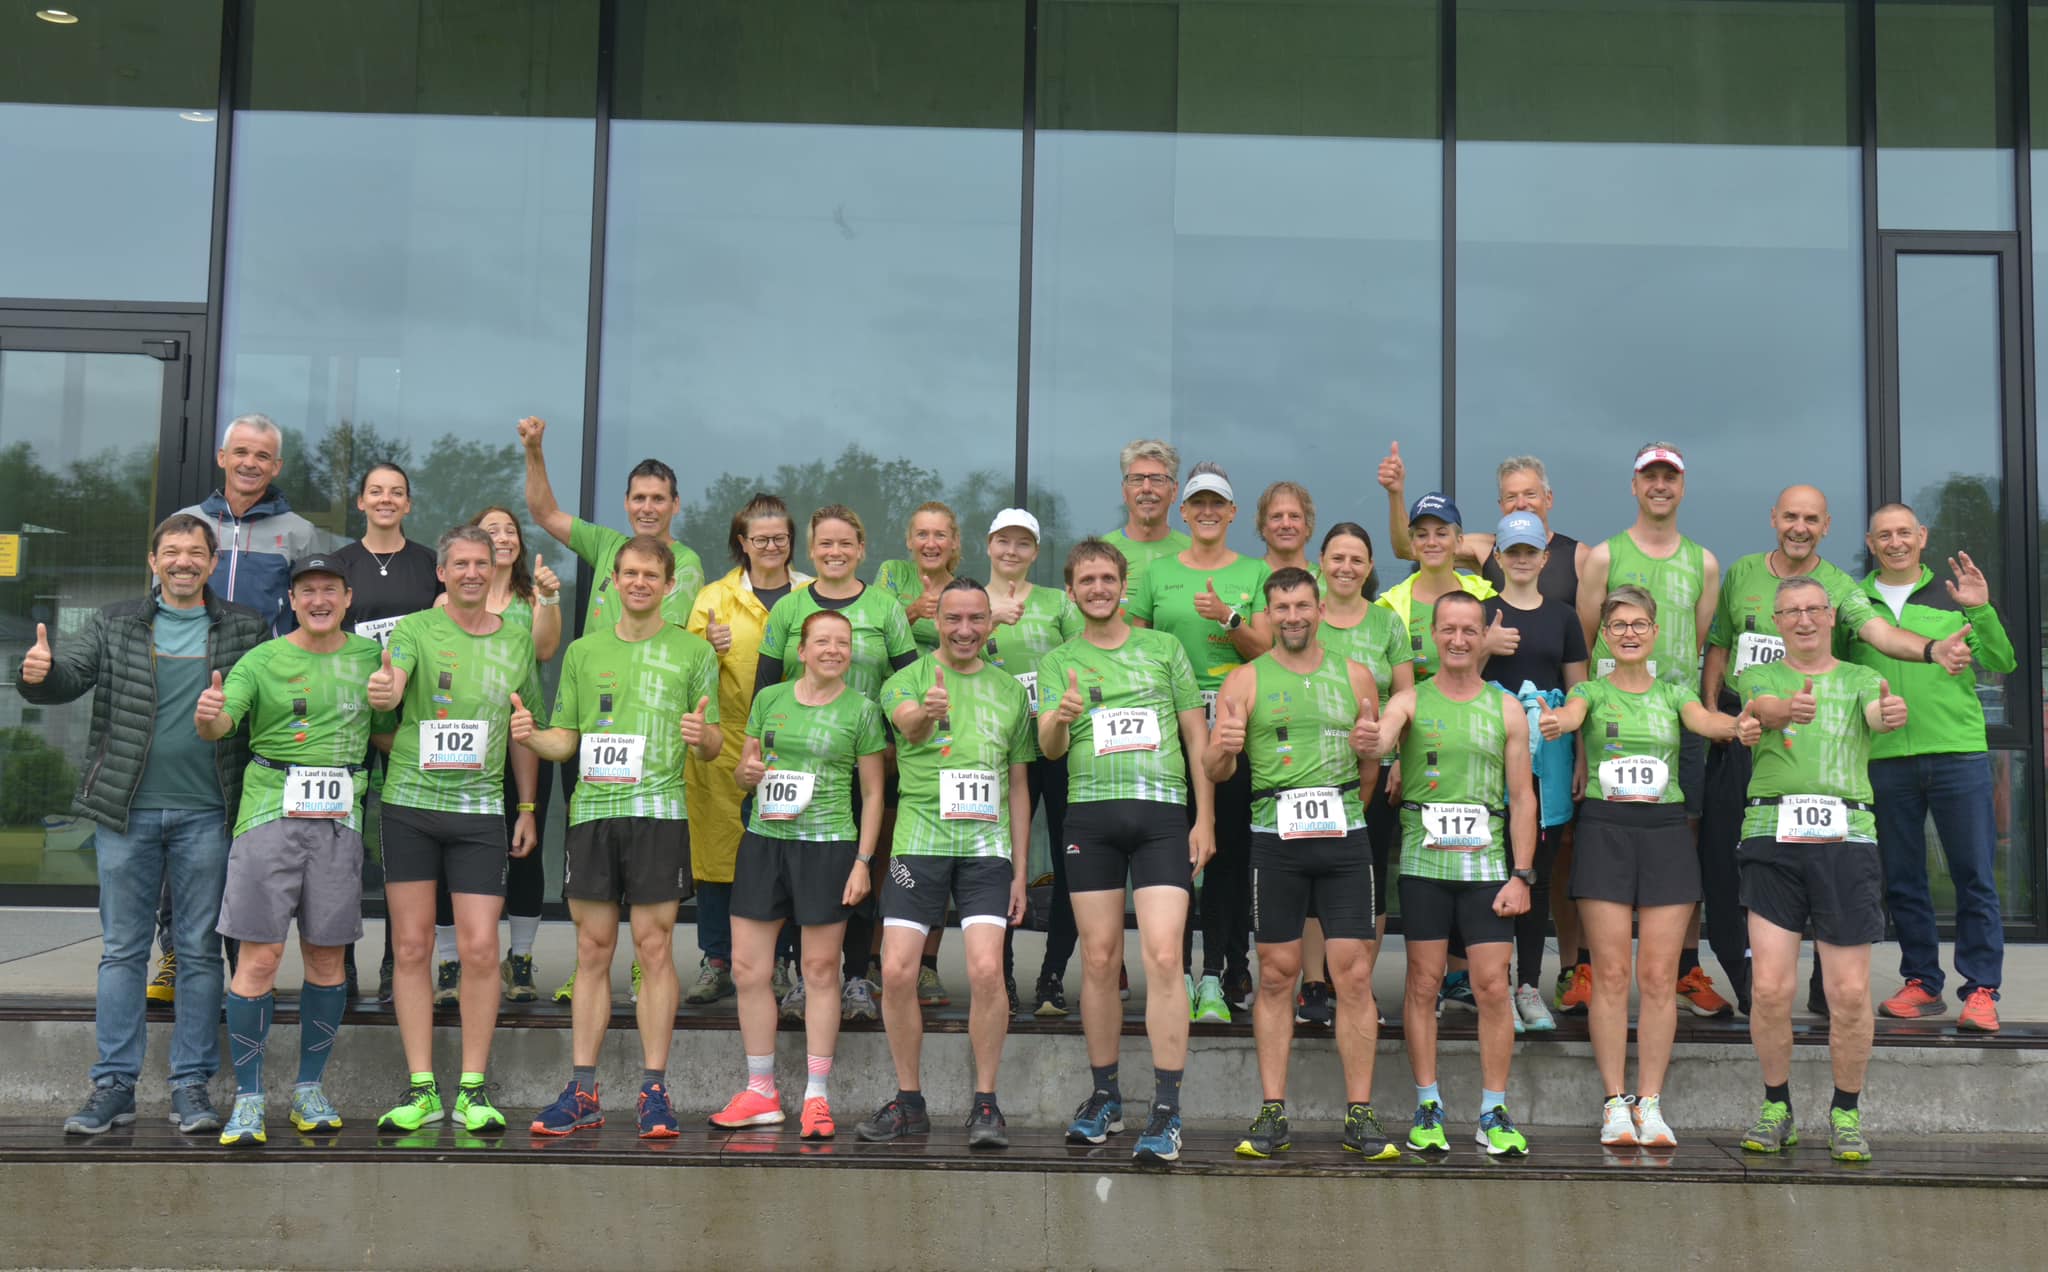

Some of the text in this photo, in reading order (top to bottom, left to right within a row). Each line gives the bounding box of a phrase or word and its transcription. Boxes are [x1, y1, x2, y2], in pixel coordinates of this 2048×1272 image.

[1750, 645, 1785, 664] 108
[1107, 718, 1144, 736] 127
[435, 732, 473, 751] 102
[593, 746, 628, 765] 104
[1615, 767, 1653, 784] 119
[301, 780, 340, 800] 110
[765, 782, 798, 802] 106
[956, 782, 989, 802] 111
[1293, 800, 1328, 819] 101
[1793, 807, 1831, 827] 103
[1438, 816, 1476, 834] 117
